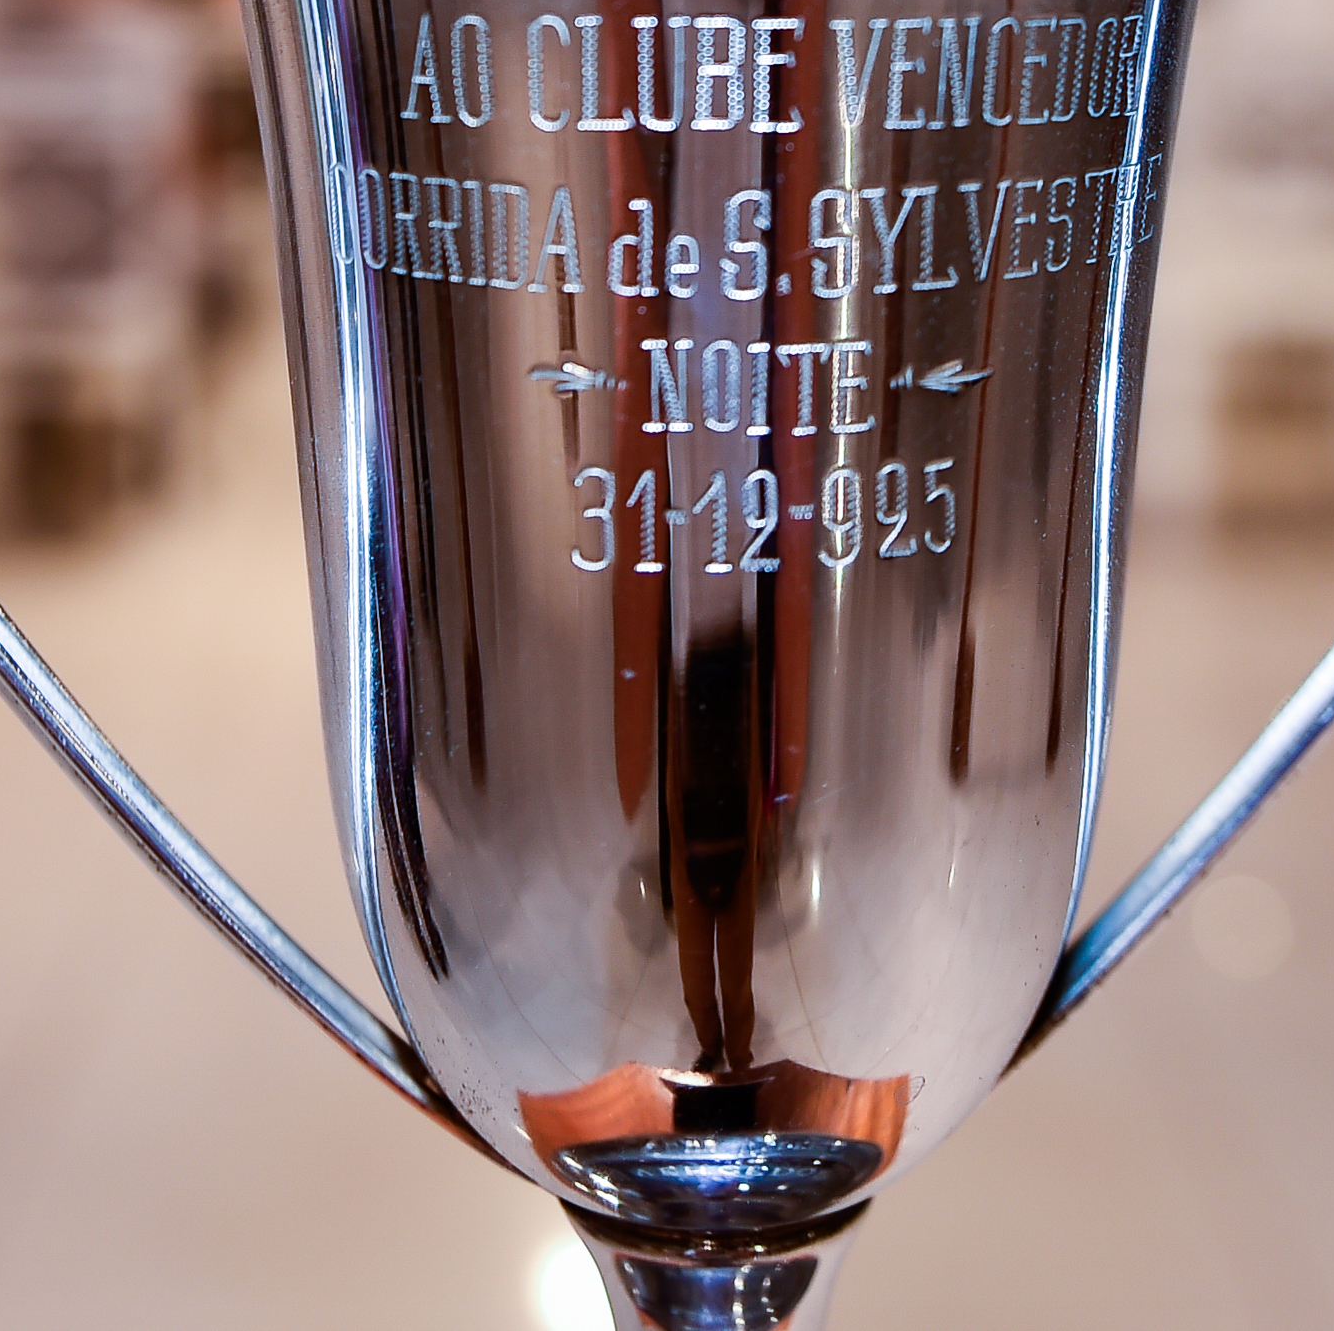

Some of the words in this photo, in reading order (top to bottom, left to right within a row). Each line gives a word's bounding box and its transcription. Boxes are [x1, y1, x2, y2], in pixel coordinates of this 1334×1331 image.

[399, 12, 490, 127] AO
[526, 13, 805, 133] CLUBE
[827, 13, 1143, 132] VENCEDOR
[329, 162, 585, 294] CORRIDA
[607, 197, 701, 299] de
[640, 338, 877, 436] NOITE
[570, 456, 957, 573] 31-12-925
